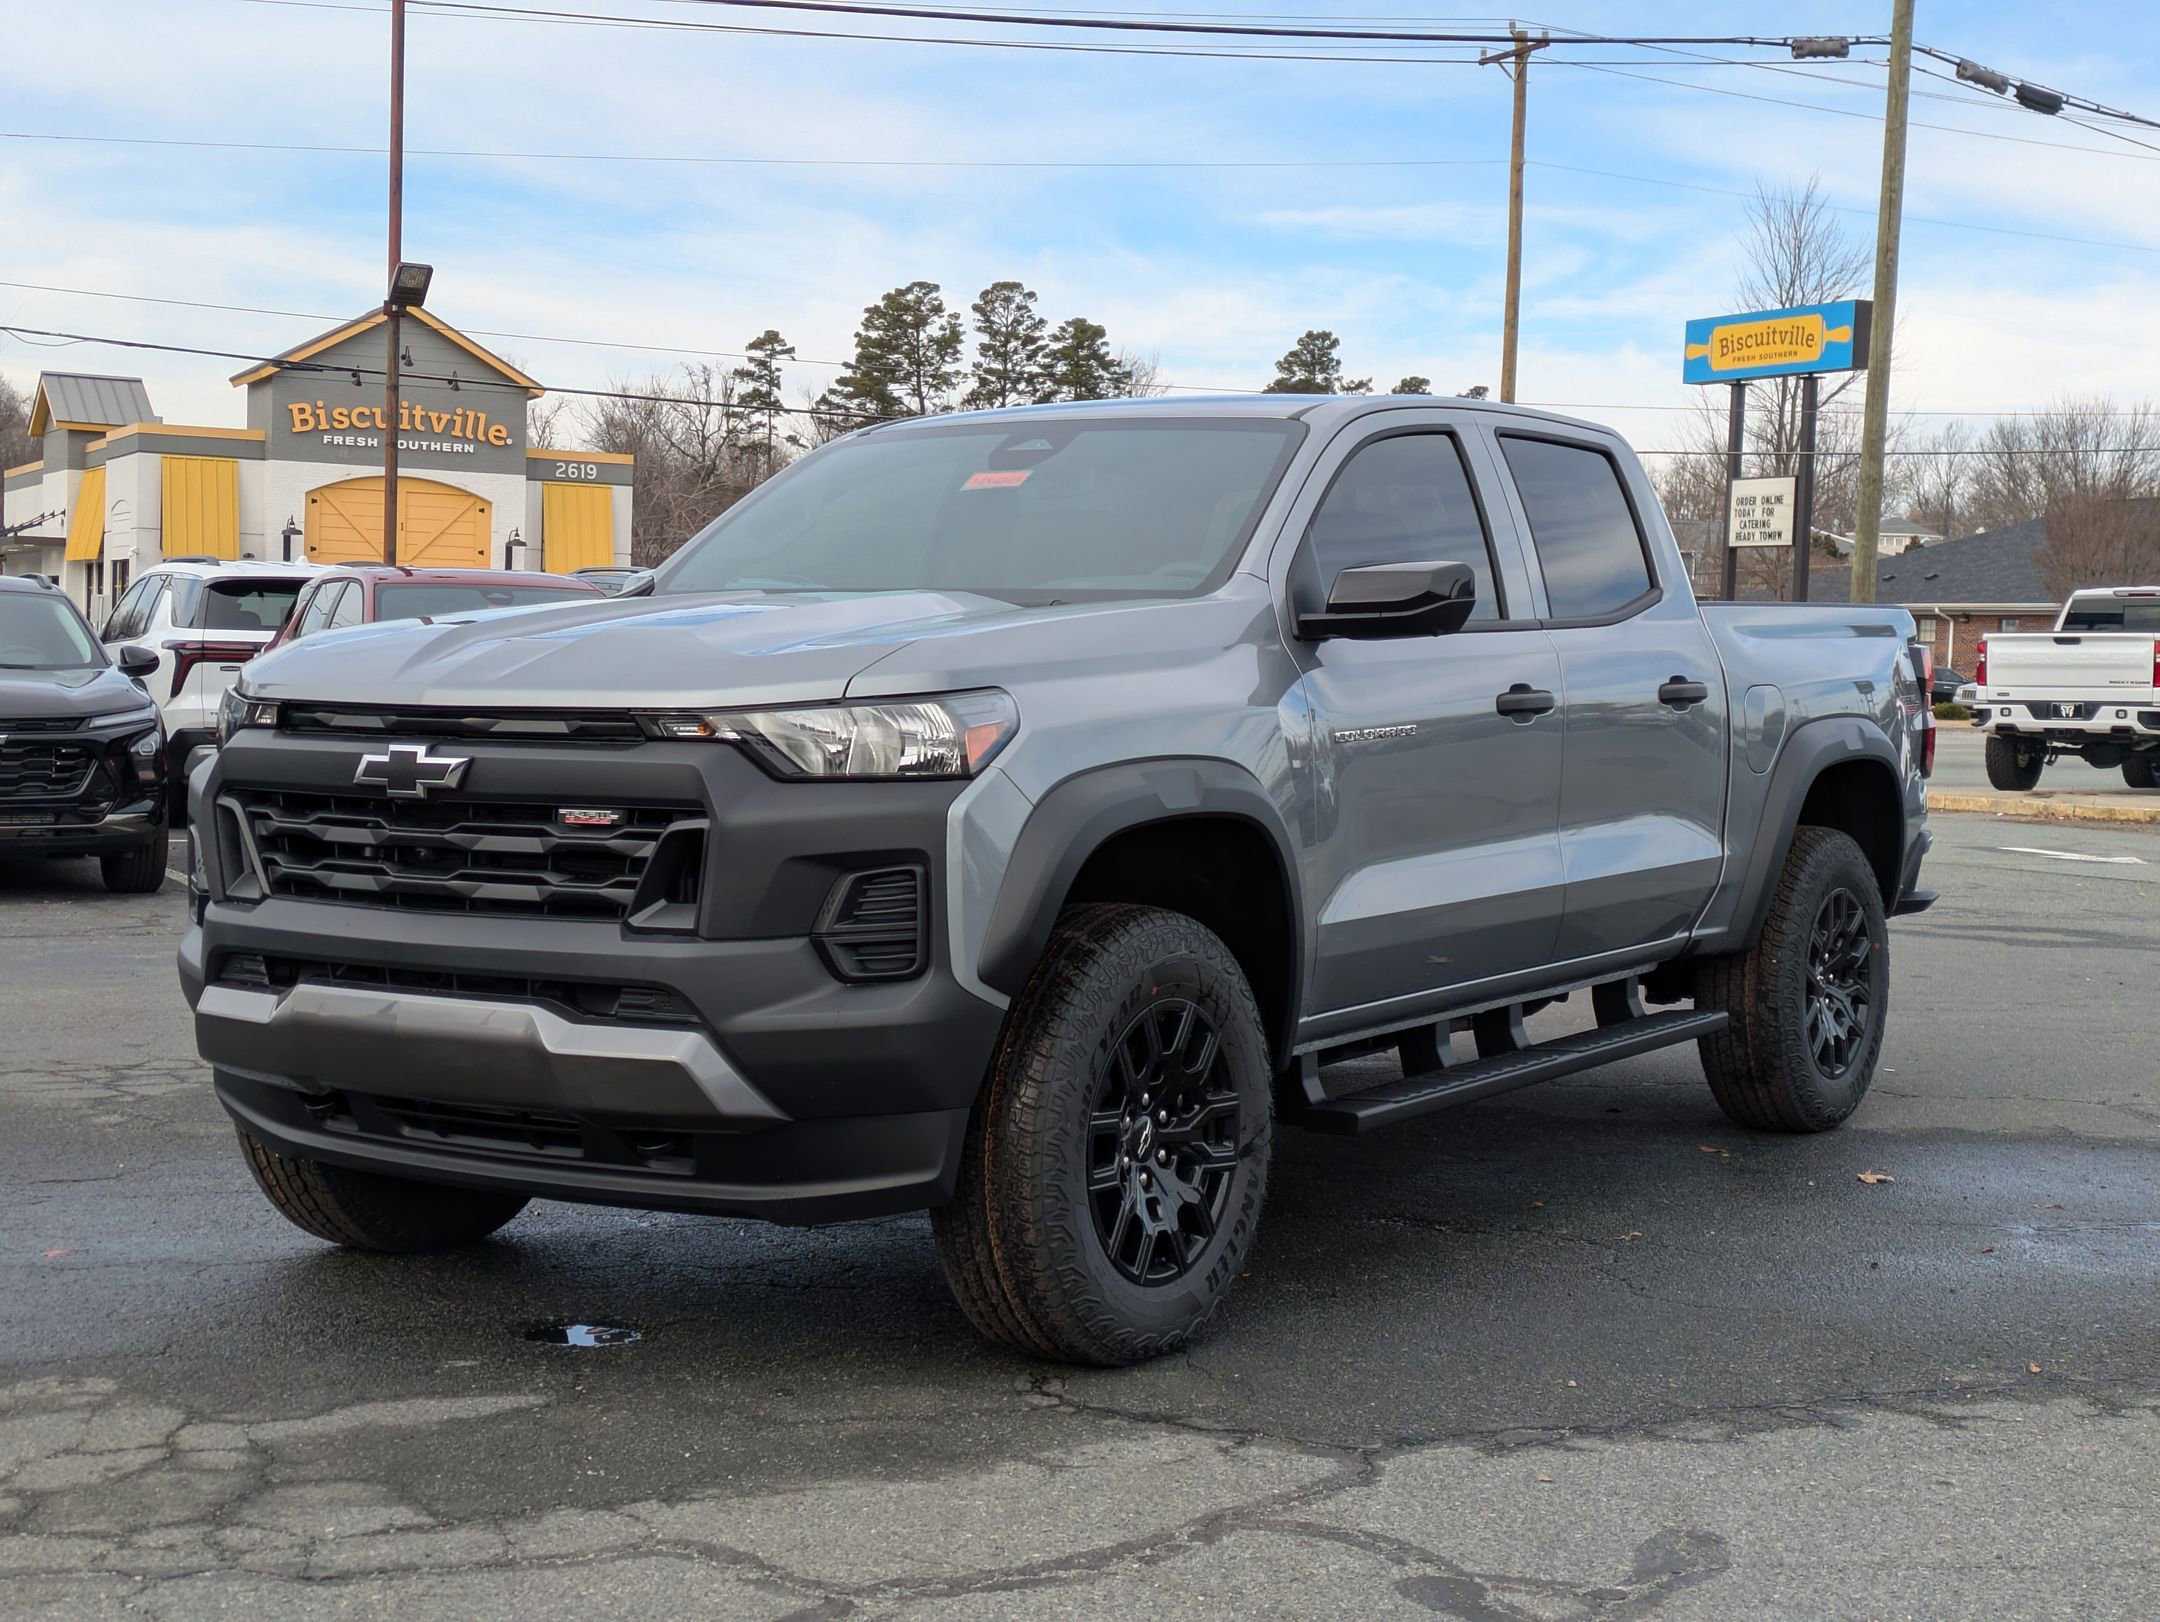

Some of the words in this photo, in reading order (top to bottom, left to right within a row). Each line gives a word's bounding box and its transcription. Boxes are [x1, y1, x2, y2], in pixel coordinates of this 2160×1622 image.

[1719, 325, 1815, 358] Biscuitville
[1732, 355, 1756, 363] FRESH
[1759, 350, 1798, 361] SOUTHERN
[323, 434, 378, 447] FRESH
[397, 439, 475, 454] OUTHERN
[555, 462, 598, 481] 2619
[1735, 496, 1757, 506] ORDER
[1761, 494, 1784, 505] ONLINE
[1734, 508, 1756, 518] TODAY
[1762, 507, 1775, 517] FOR
[1739, 519, 1771, 530] CATERING
[1735, 531, 1756, 542] READY
[1760, 531, 1783, 541] TOMRW
